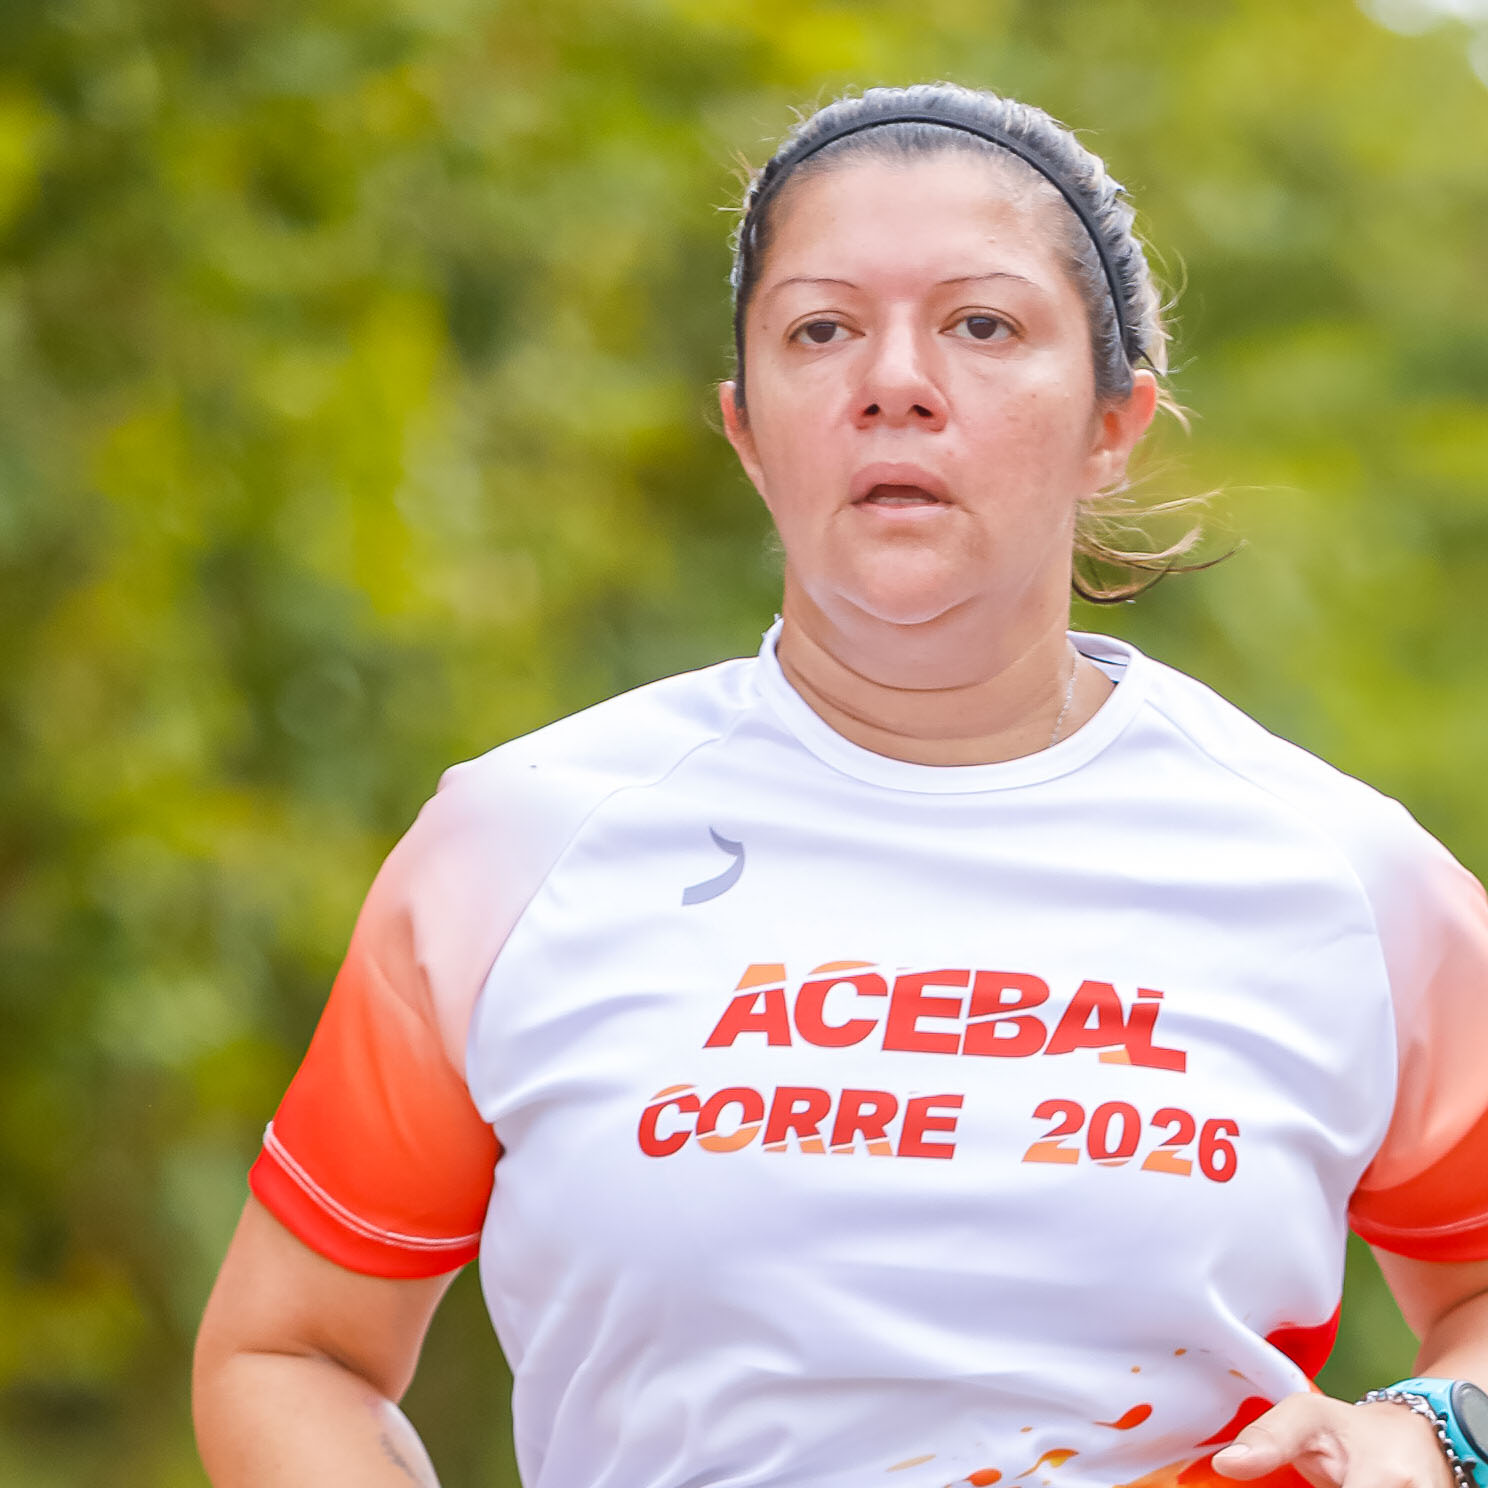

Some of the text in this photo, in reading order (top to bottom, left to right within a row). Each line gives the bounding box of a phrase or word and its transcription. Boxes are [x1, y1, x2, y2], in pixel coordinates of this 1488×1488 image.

[702, 960, 1187, 1073] ACEBAL
[637, 1084, 1240, 1183] CORRE 2026
